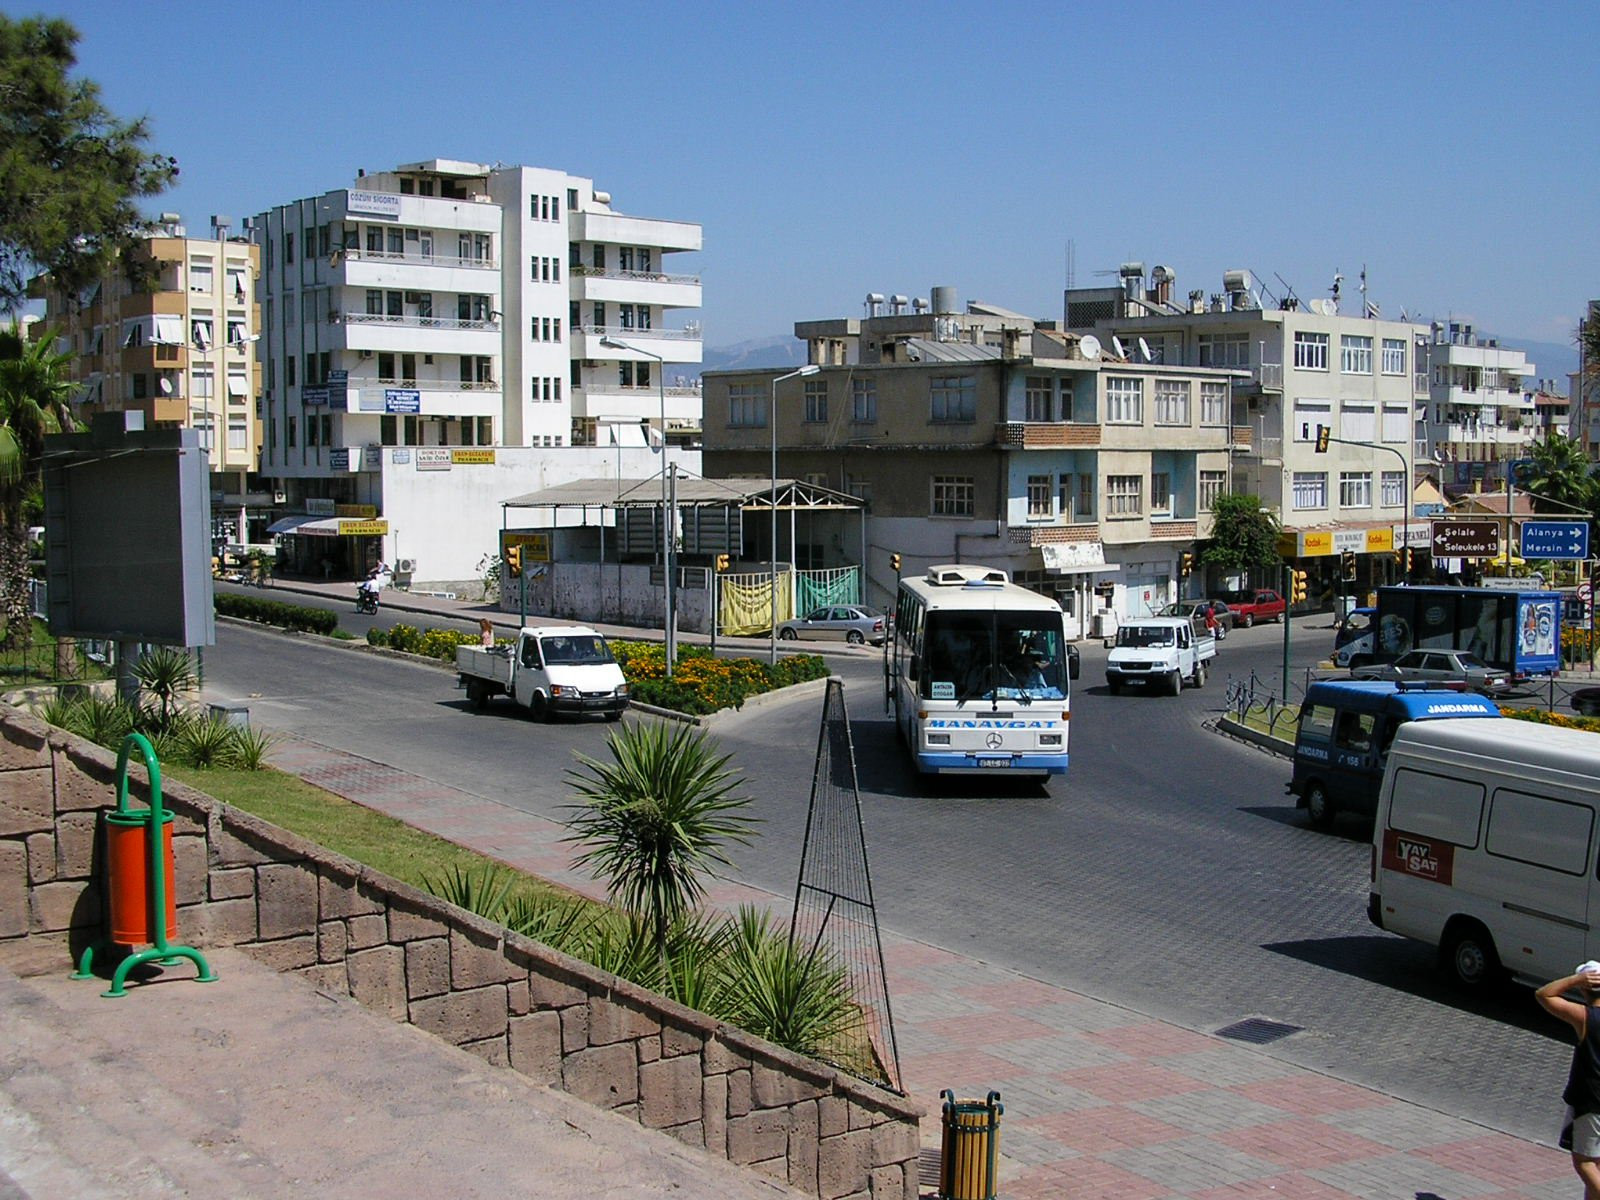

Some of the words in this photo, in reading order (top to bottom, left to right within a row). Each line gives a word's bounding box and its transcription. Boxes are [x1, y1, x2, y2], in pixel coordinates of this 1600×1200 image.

[1490, 527, 1498, 537] 4
[1526, 527, 1564, 538] Alanya
[1305, 536, 1321, 548] Kodak
[1368, 533, 1383, 544] Kodak
[1487, 542, 1498, 552] 13
[1526, 542, 1563, 552] Mersin
[1427, 703, 1488, 714] JANDARMA
[929, 720, 1057, 729] MANAVGAT
[1296, 745, 1329, 761] JANDARMA
[1399, 840, 1428, 860] YAY
[1409, 857, 1438, 872] SAT
